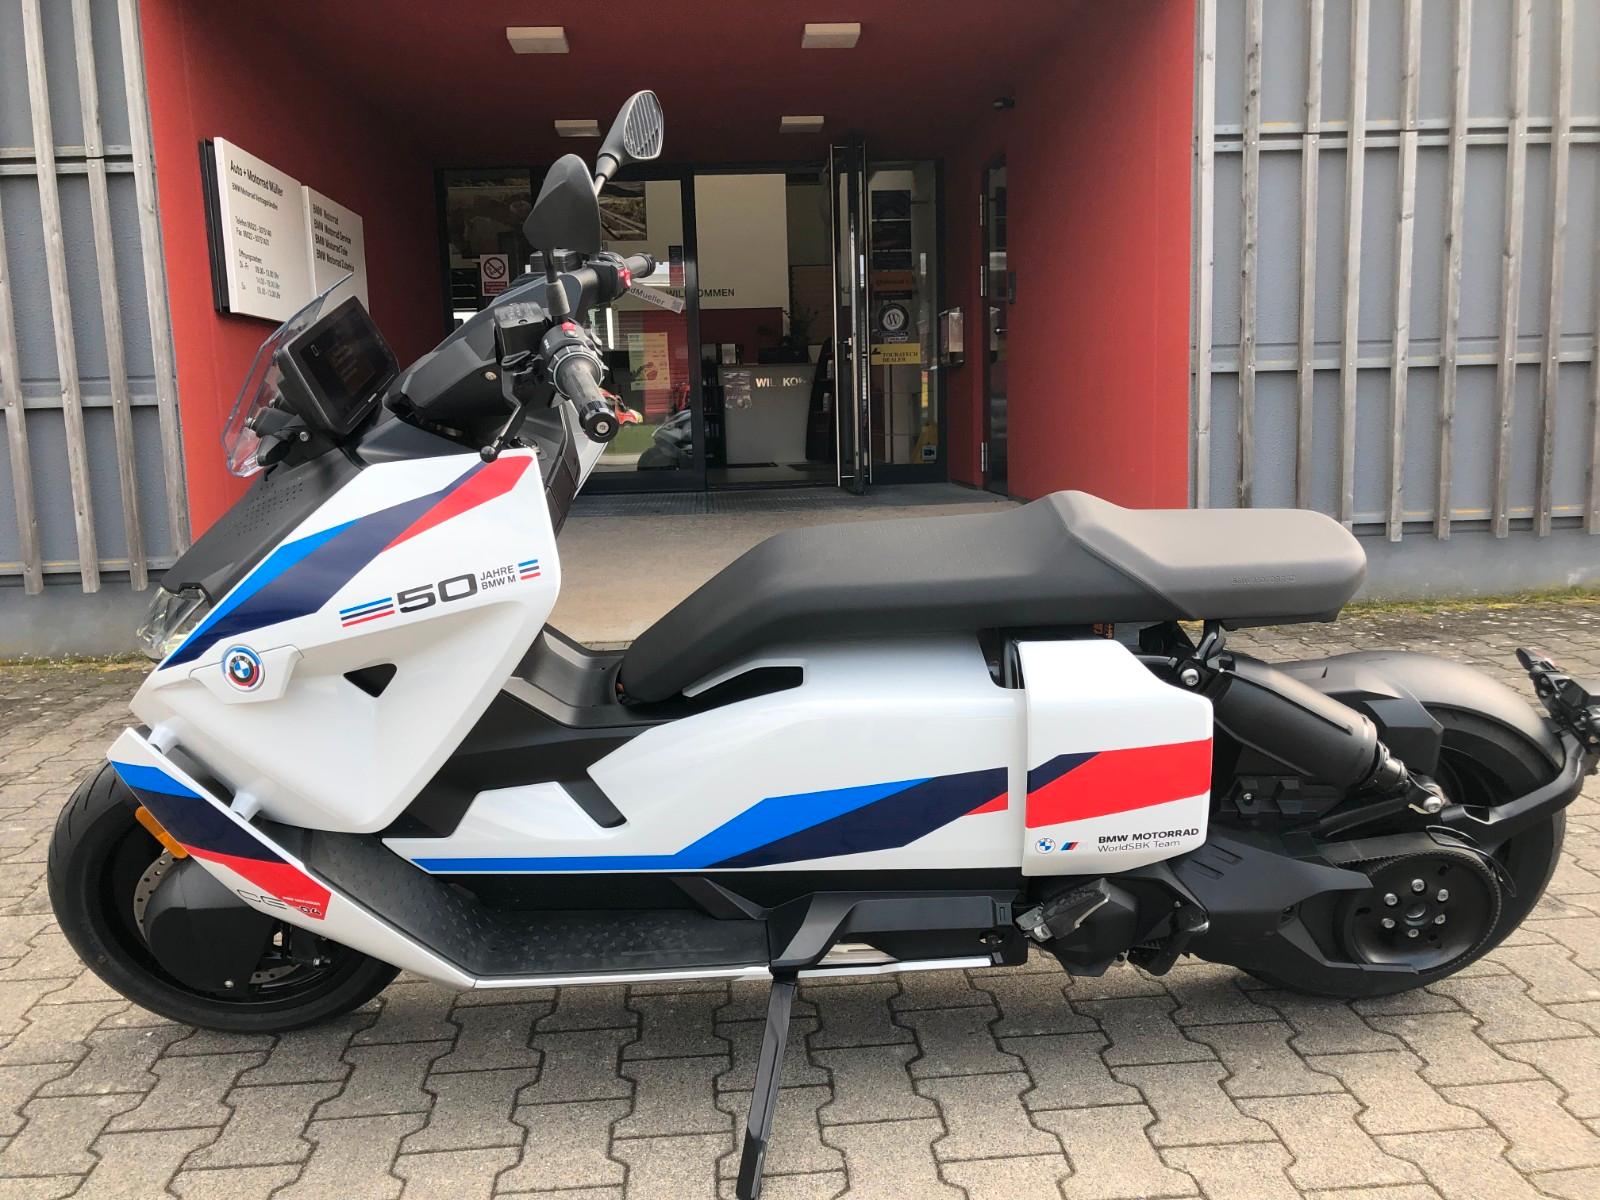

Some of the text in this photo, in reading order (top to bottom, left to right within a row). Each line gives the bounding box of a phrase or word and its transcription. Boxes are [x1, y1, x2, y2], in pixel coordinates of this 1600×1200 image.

[230, 159, 243, 176] Auto
[247, 169, 269, 190] Motorrad
[313, 203, 323, 216] BMW
[314, 218, 324, 232] BMW
[315, 233, 325, 246] BMW
[316, 248, 326, 261] BMW
[480, 564, 514, 581] JAHRE
[481, 574, 516, 590] BMW M
[396, 573, 478, 613] 50
[1098, 828, 1199, 844] BMW MOTORRAD
[1097, 840, 1181, 853] WorldSBK Team
